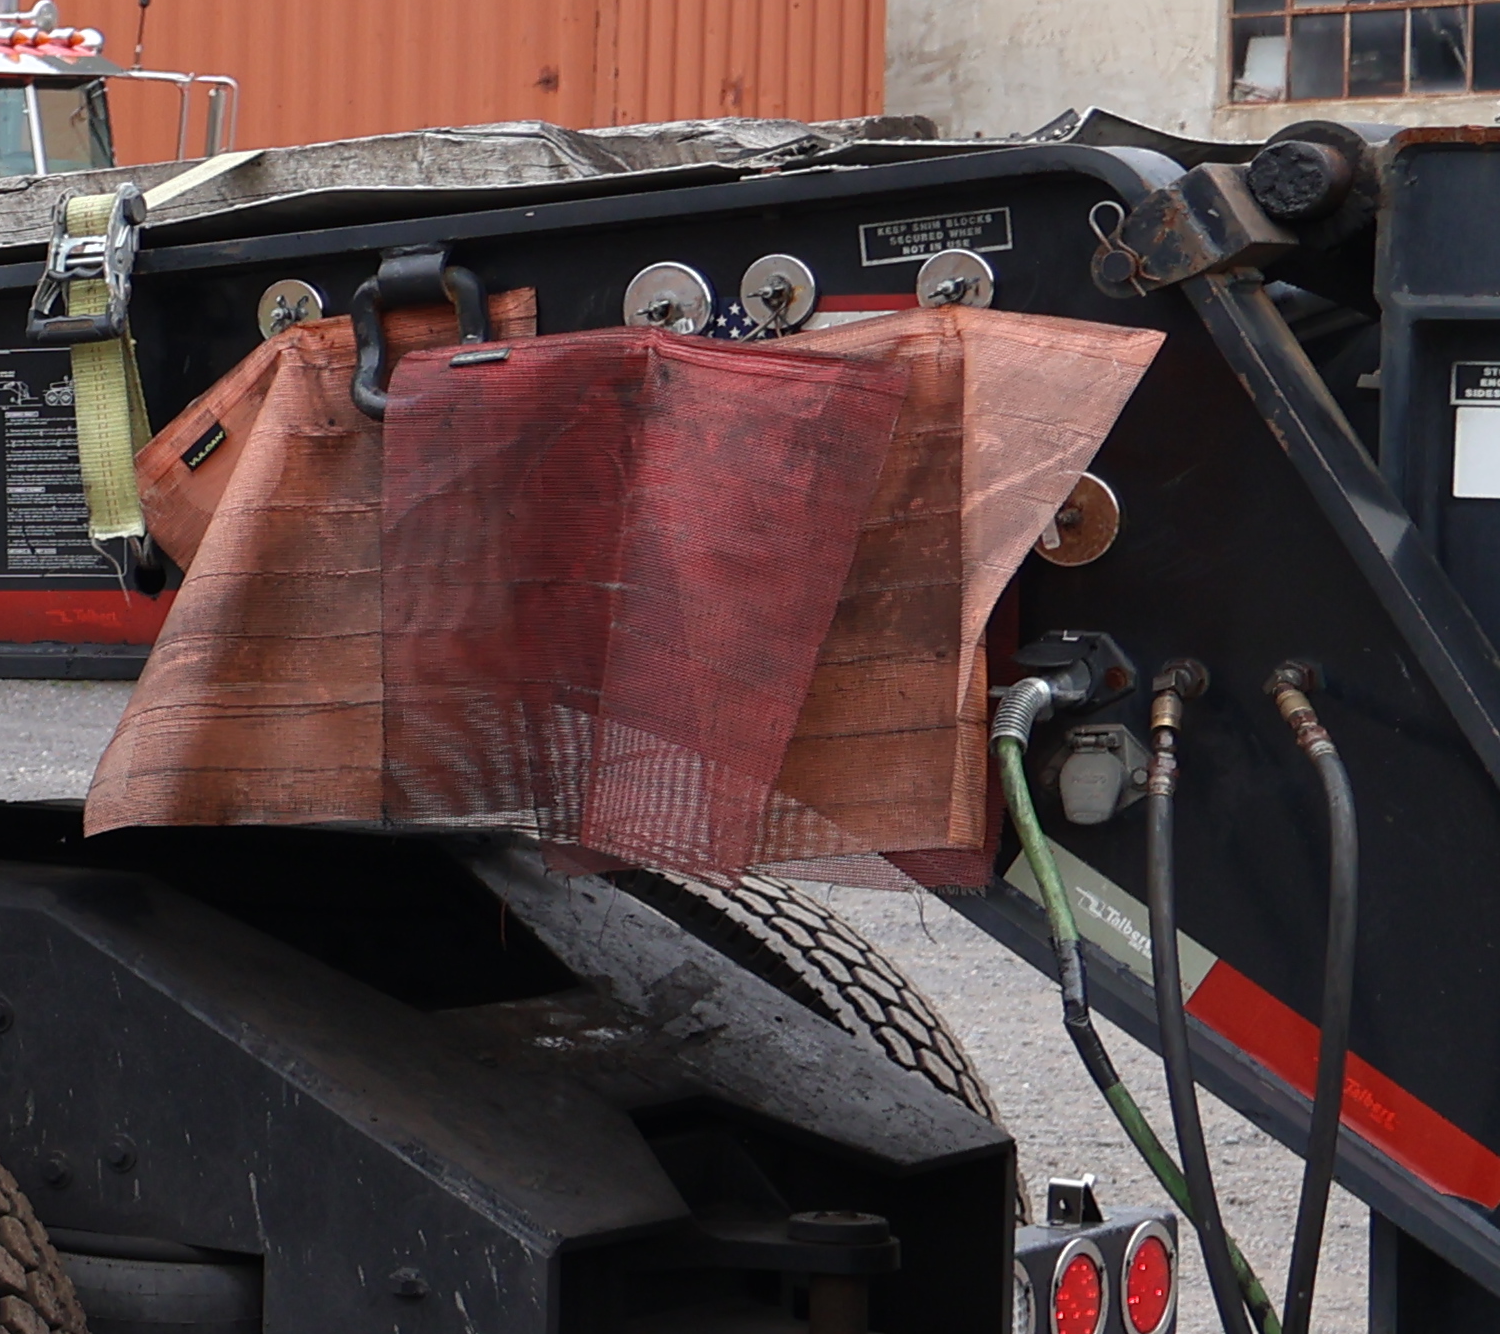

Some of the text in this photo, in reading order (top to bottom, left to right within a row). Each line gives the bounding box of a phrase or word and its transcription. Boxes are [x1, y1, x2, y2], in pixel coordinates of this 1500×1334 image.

[877, 214, 993, 236] KEEP SHIM BLOCKS
[889, 226, 982, 246] SECURED WHEN
[902, 238, 971, 255] NOT IN USE
[1483, 367, 1500, 376] ST
